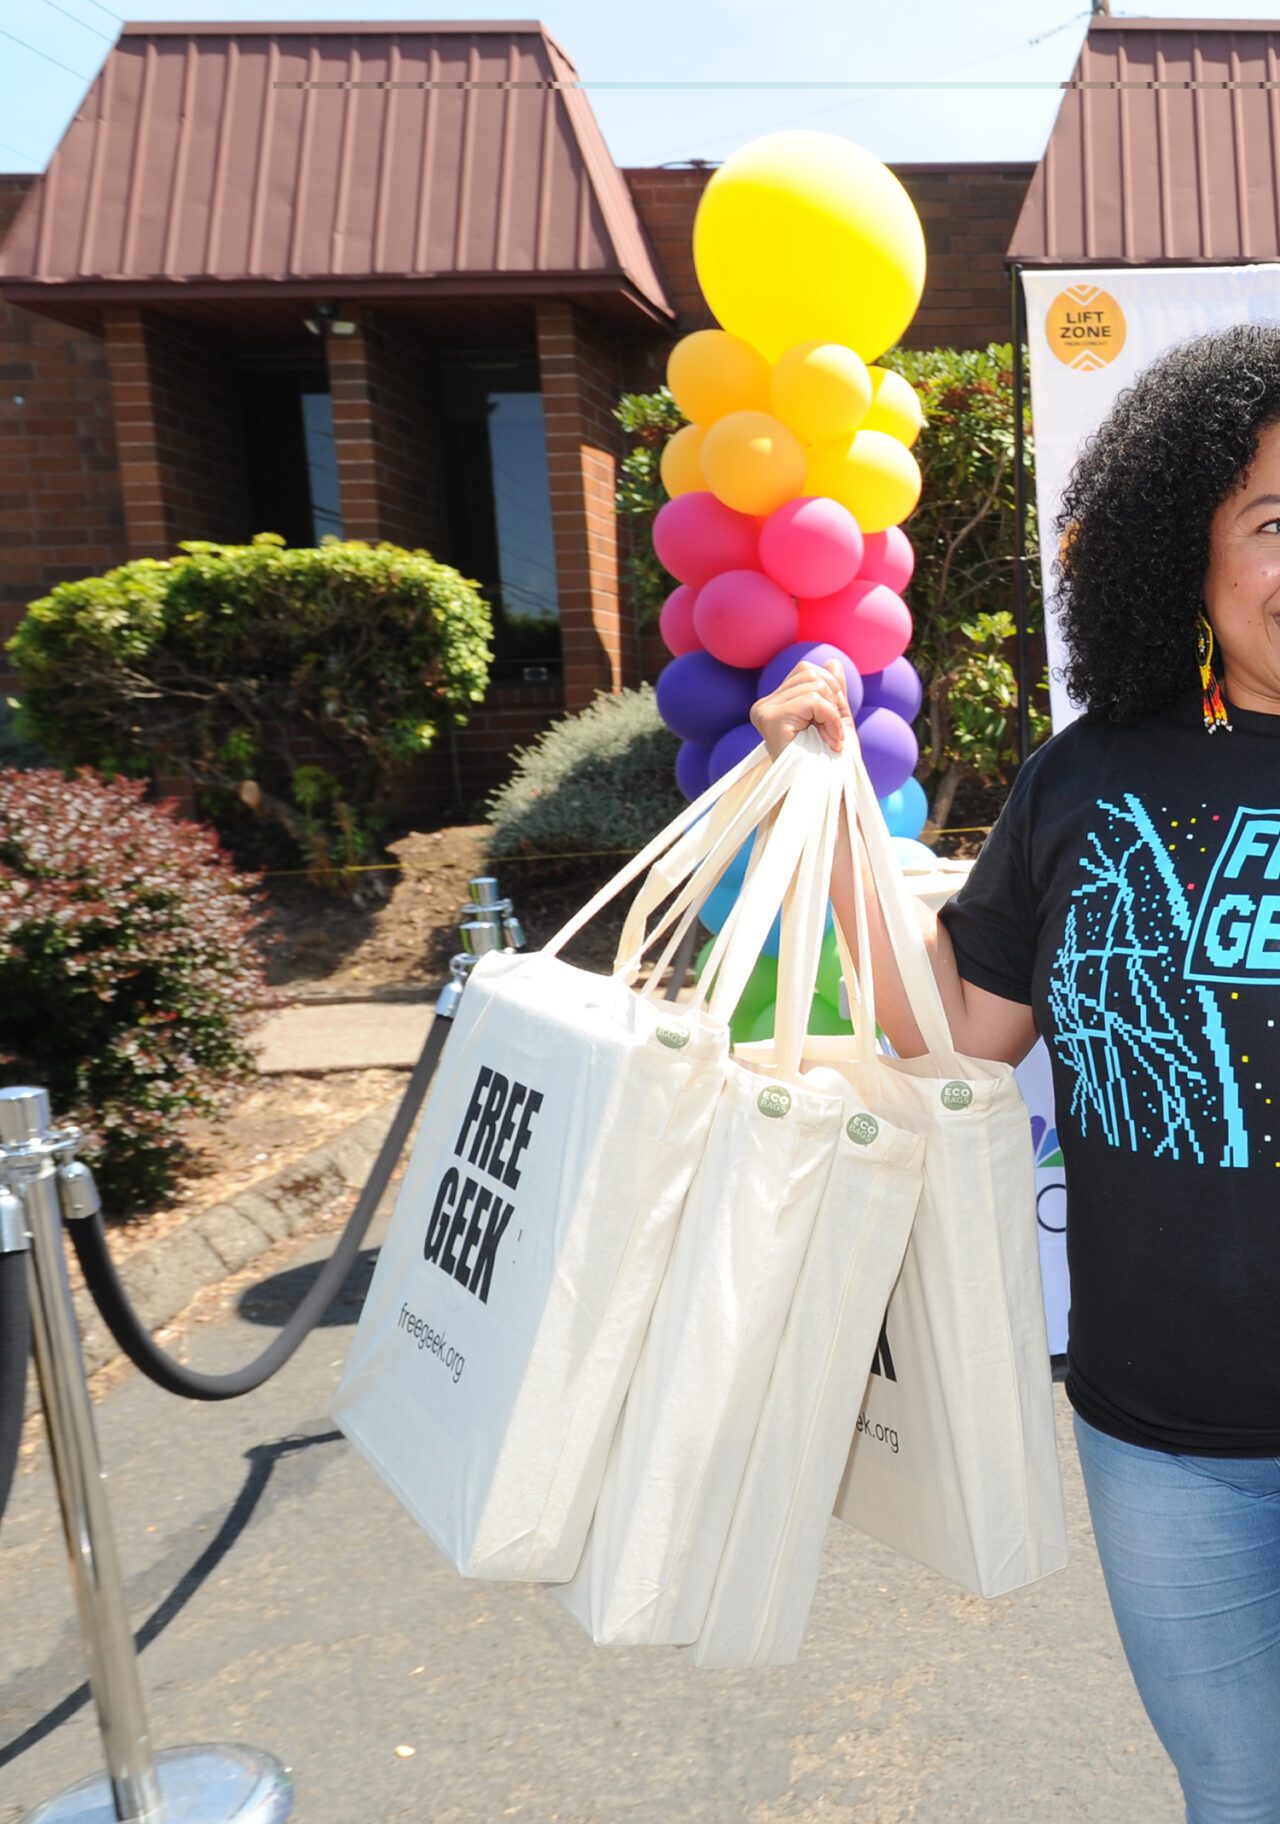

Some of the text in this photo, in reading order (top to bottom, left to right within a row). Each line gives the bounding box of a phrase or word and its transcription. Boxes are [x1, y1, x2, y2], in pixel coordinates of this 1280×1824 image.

[1066, 311, 1105, 324] LIFT
[1060, 325, 1112, 338] ZONE
[657, 1029, 685, 1046] BAGS
[763, 1090, 789, 1105] ECO
[943, 1096, 970, 1105] BAGS
[944, 1088, 970, 1097] ECO
[759, 1099, 786, 1114] BAGS
[454, 1065, 544, 1191] FREE
[848, 1124, 872, 1143] BAGS
[853, 1116, 877, 1135] ECO
[423, 1166, 515, 1305] GEEK
[398, 1302, 465, 1383] freegeek.org
